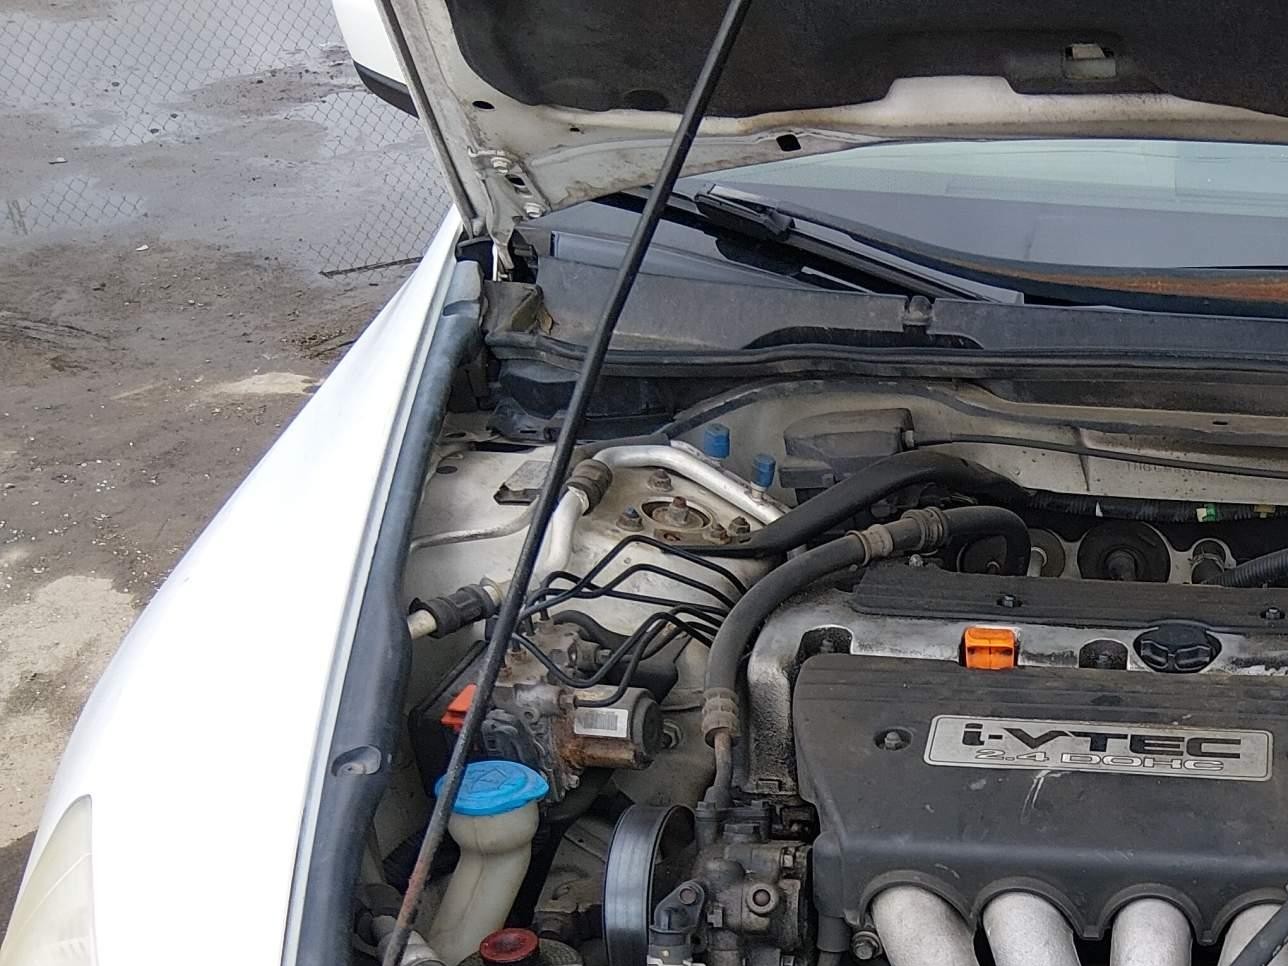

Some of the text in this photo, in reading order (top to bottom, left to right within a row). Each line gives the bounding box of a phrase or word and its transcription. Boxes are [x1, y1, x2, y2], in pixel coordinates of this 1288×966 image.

[962, 722, 1241, 759] i-VTEC
[974, 749, 1224, 772] 2.4 DOHC
